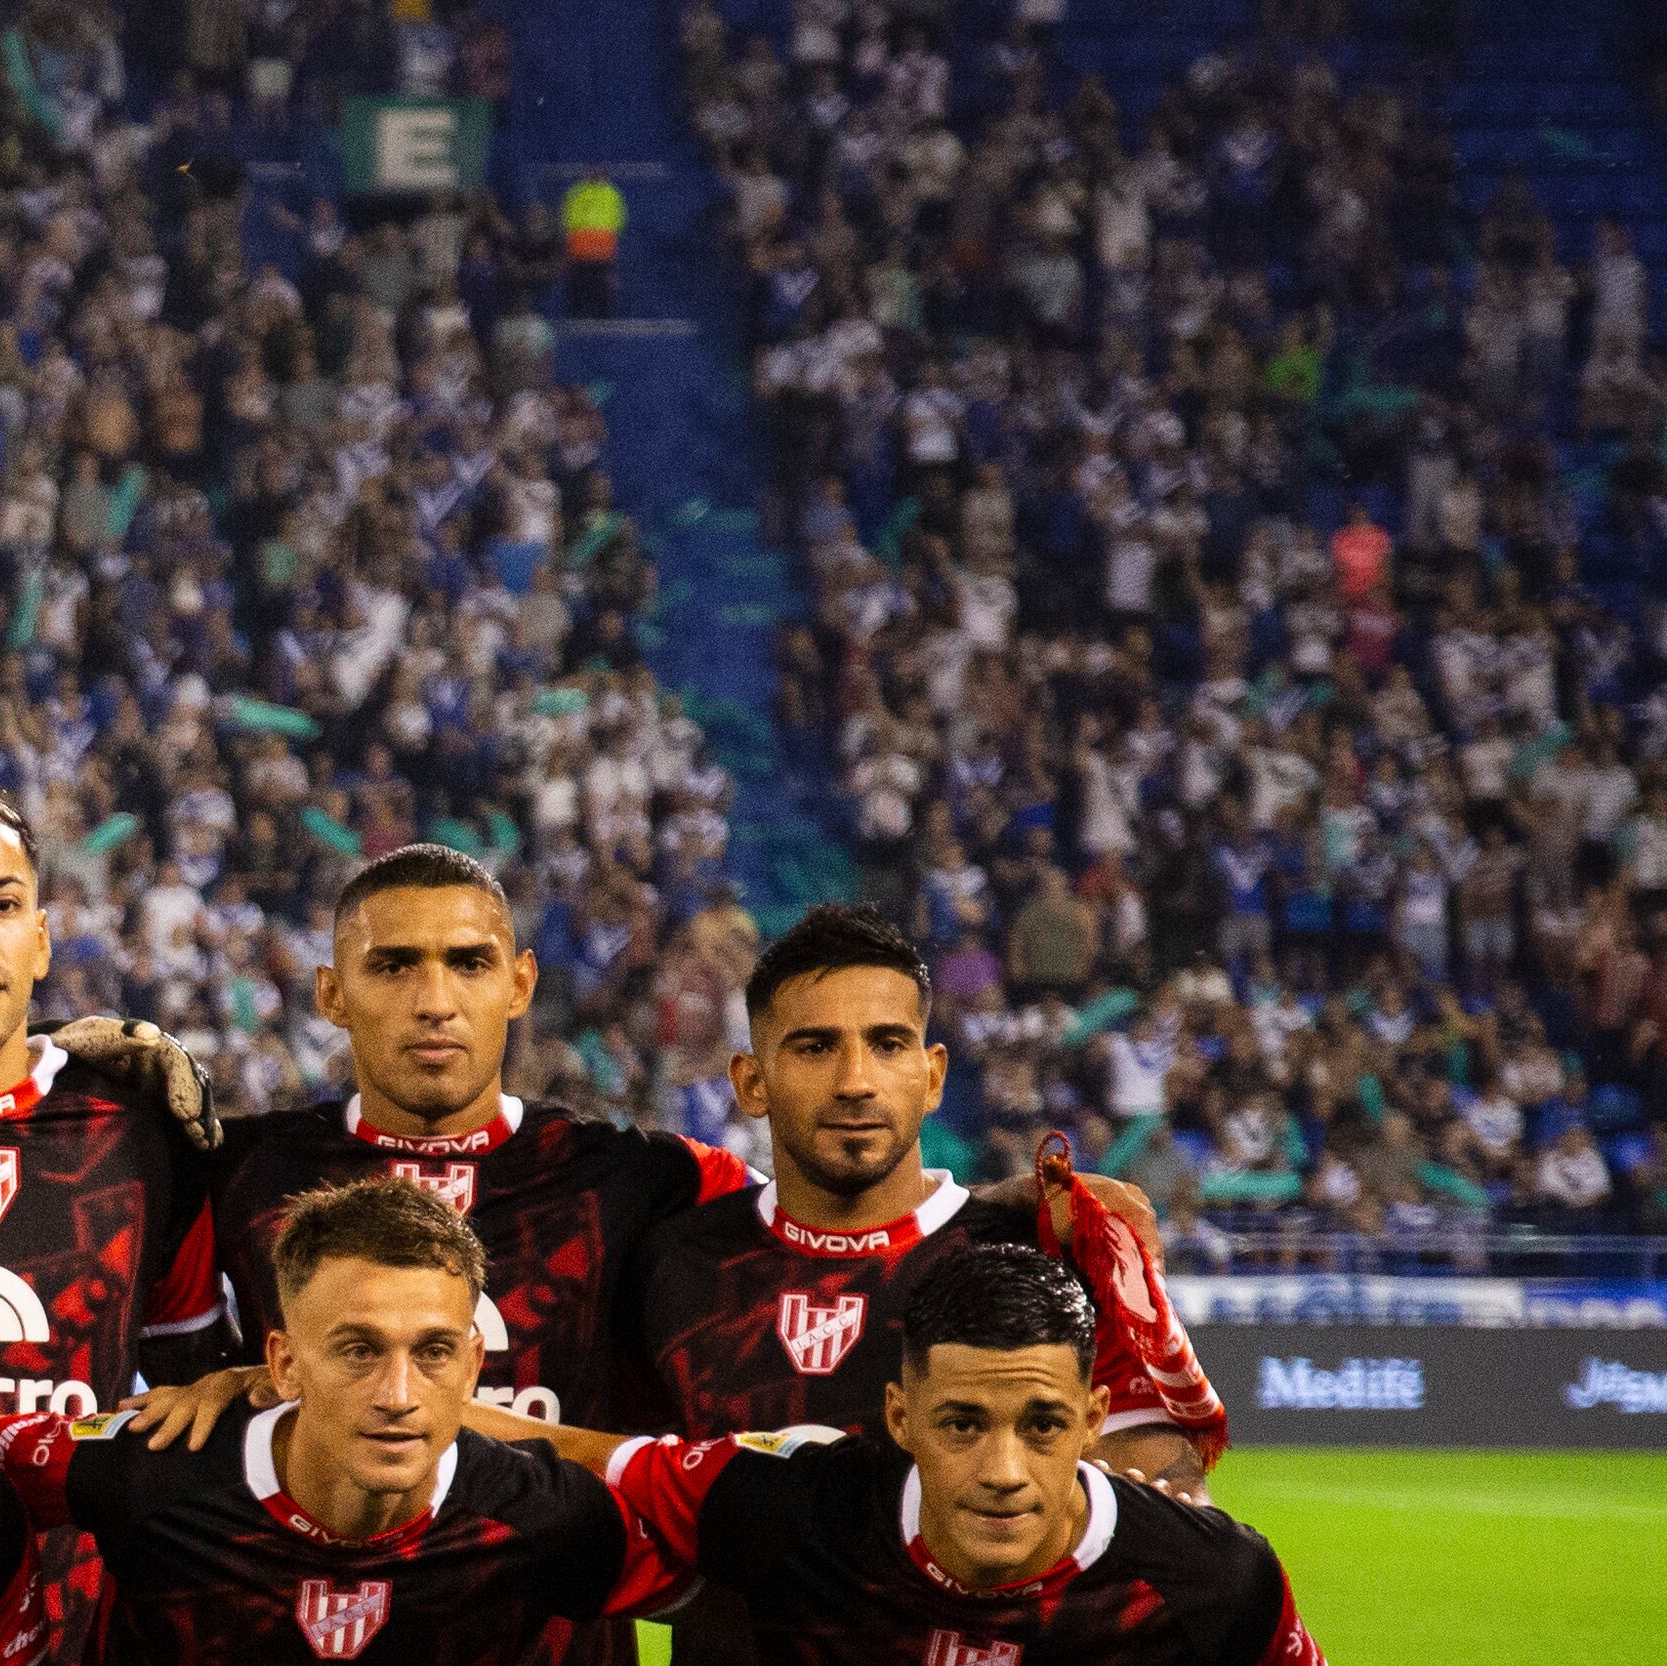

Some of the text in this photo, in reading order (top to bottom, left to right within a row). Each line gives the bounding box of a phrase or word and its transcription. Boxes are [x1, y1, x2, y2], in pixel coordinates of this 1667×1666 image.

[375, 107, 459, 190] E
[377, 1130, 489, 1153] GIVOVA
[783, 1220, 891, 1252] GIVOVA
[926, 1562, 1044, 1598] GIVOVA
